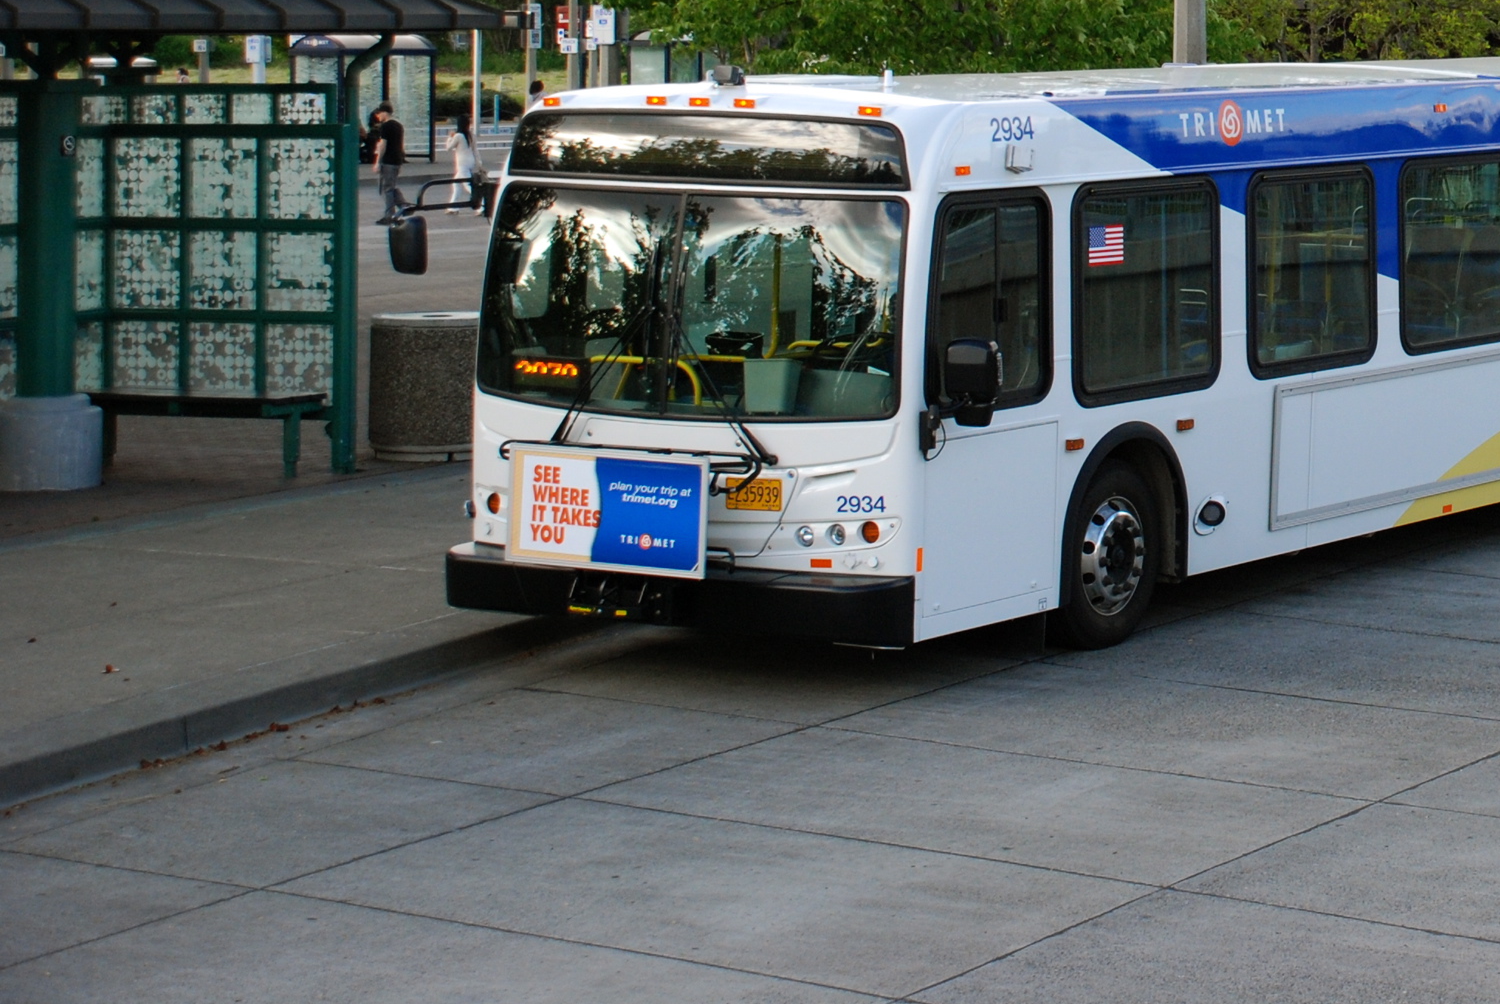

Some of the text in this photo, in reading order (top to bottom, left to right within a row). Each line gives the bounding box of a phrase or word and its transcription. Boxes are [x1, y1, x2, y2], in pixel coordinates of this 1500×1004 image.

[989, 115, 1035, 142] 2934
[1179, 108, 1285, 138] TRI MET
[533, 464, 561, 484] SEE
[532, 484, 590, 507] WHERE
[609, 481, 692, 497] plan your trip at
[622, 493, 678, 508] trimet.org
[836, 495, 887, 513] 2934
[532, 504, 601, 528] IT TAKES
[530, 523, 566, 545] YOU
[620, 534, 676, 548] TRI MET
